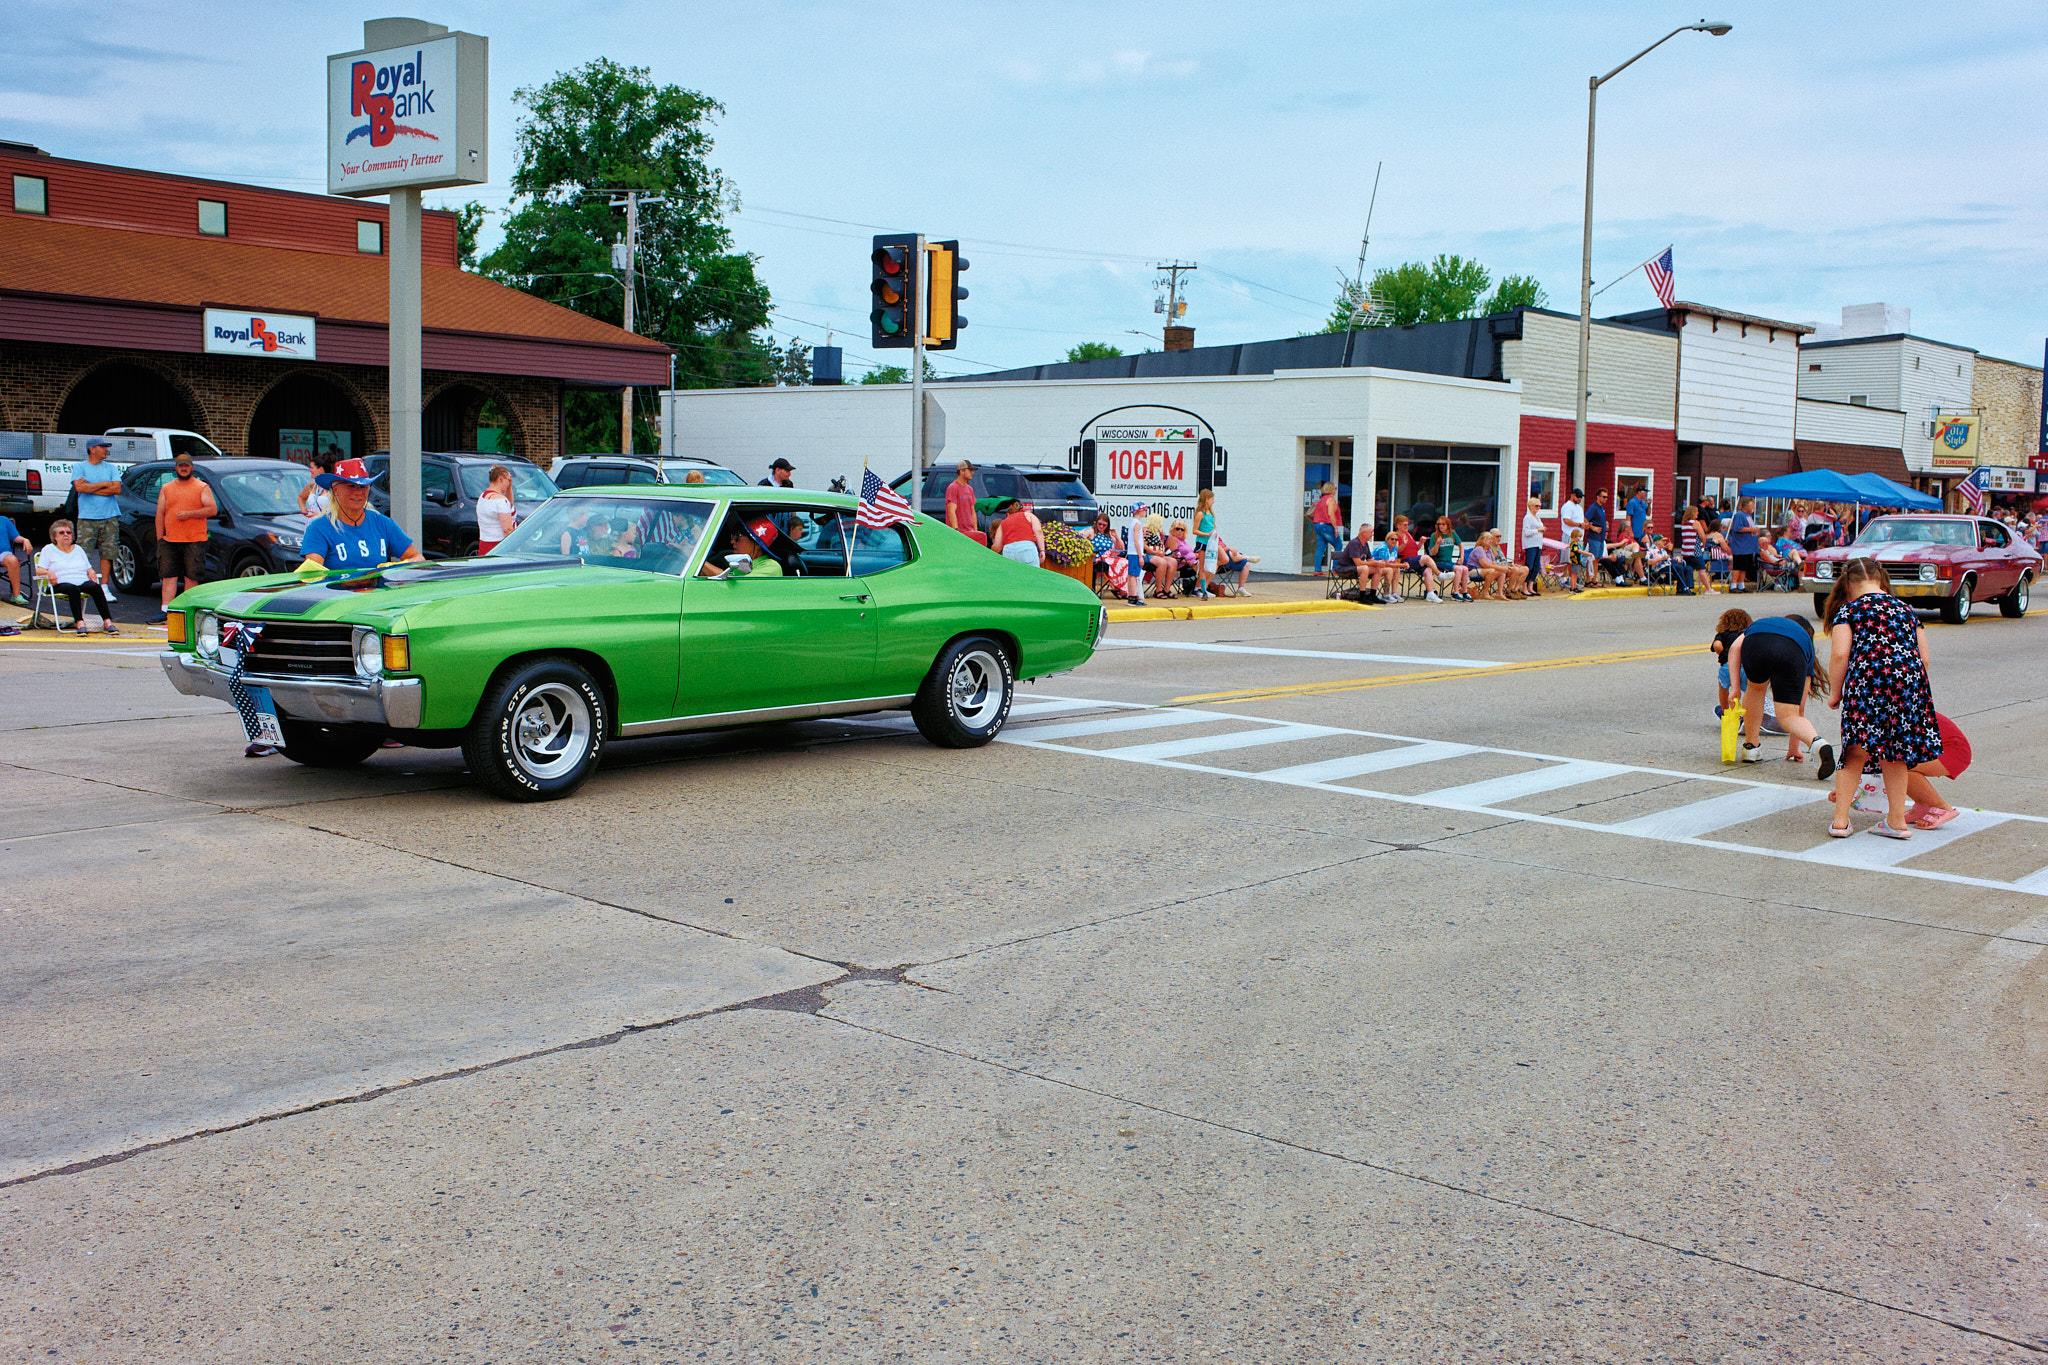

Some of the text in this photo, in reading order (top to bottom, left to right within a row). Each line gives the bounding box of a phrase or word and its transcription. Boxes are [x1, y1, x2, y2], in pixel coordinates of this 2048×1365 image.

[351, 50, 423, 117] Royal
[370, 80, 435, 148] Bank
[340, 152, 444, 181] Your Community Partner
[214, 326, 249, 343] Royal
[277, 332, 307, 345] Bank
[1101, 429, 1149, 439] WISCONSIN
[1945, 434, 1966, 447] Style
[1949, 426, 1964, 435] Old
[44, 463, 61, 473] Free
[1108, 449, 1184, 481] 106FM
[946, 652, 964, 717] UNIROYAL
[986, 649, 1013, 736] TIGER PAW GTS
[501, 683, 540, 791] TIGER PAW GTS
[581, 682, 604, 760] UNIROYAL
